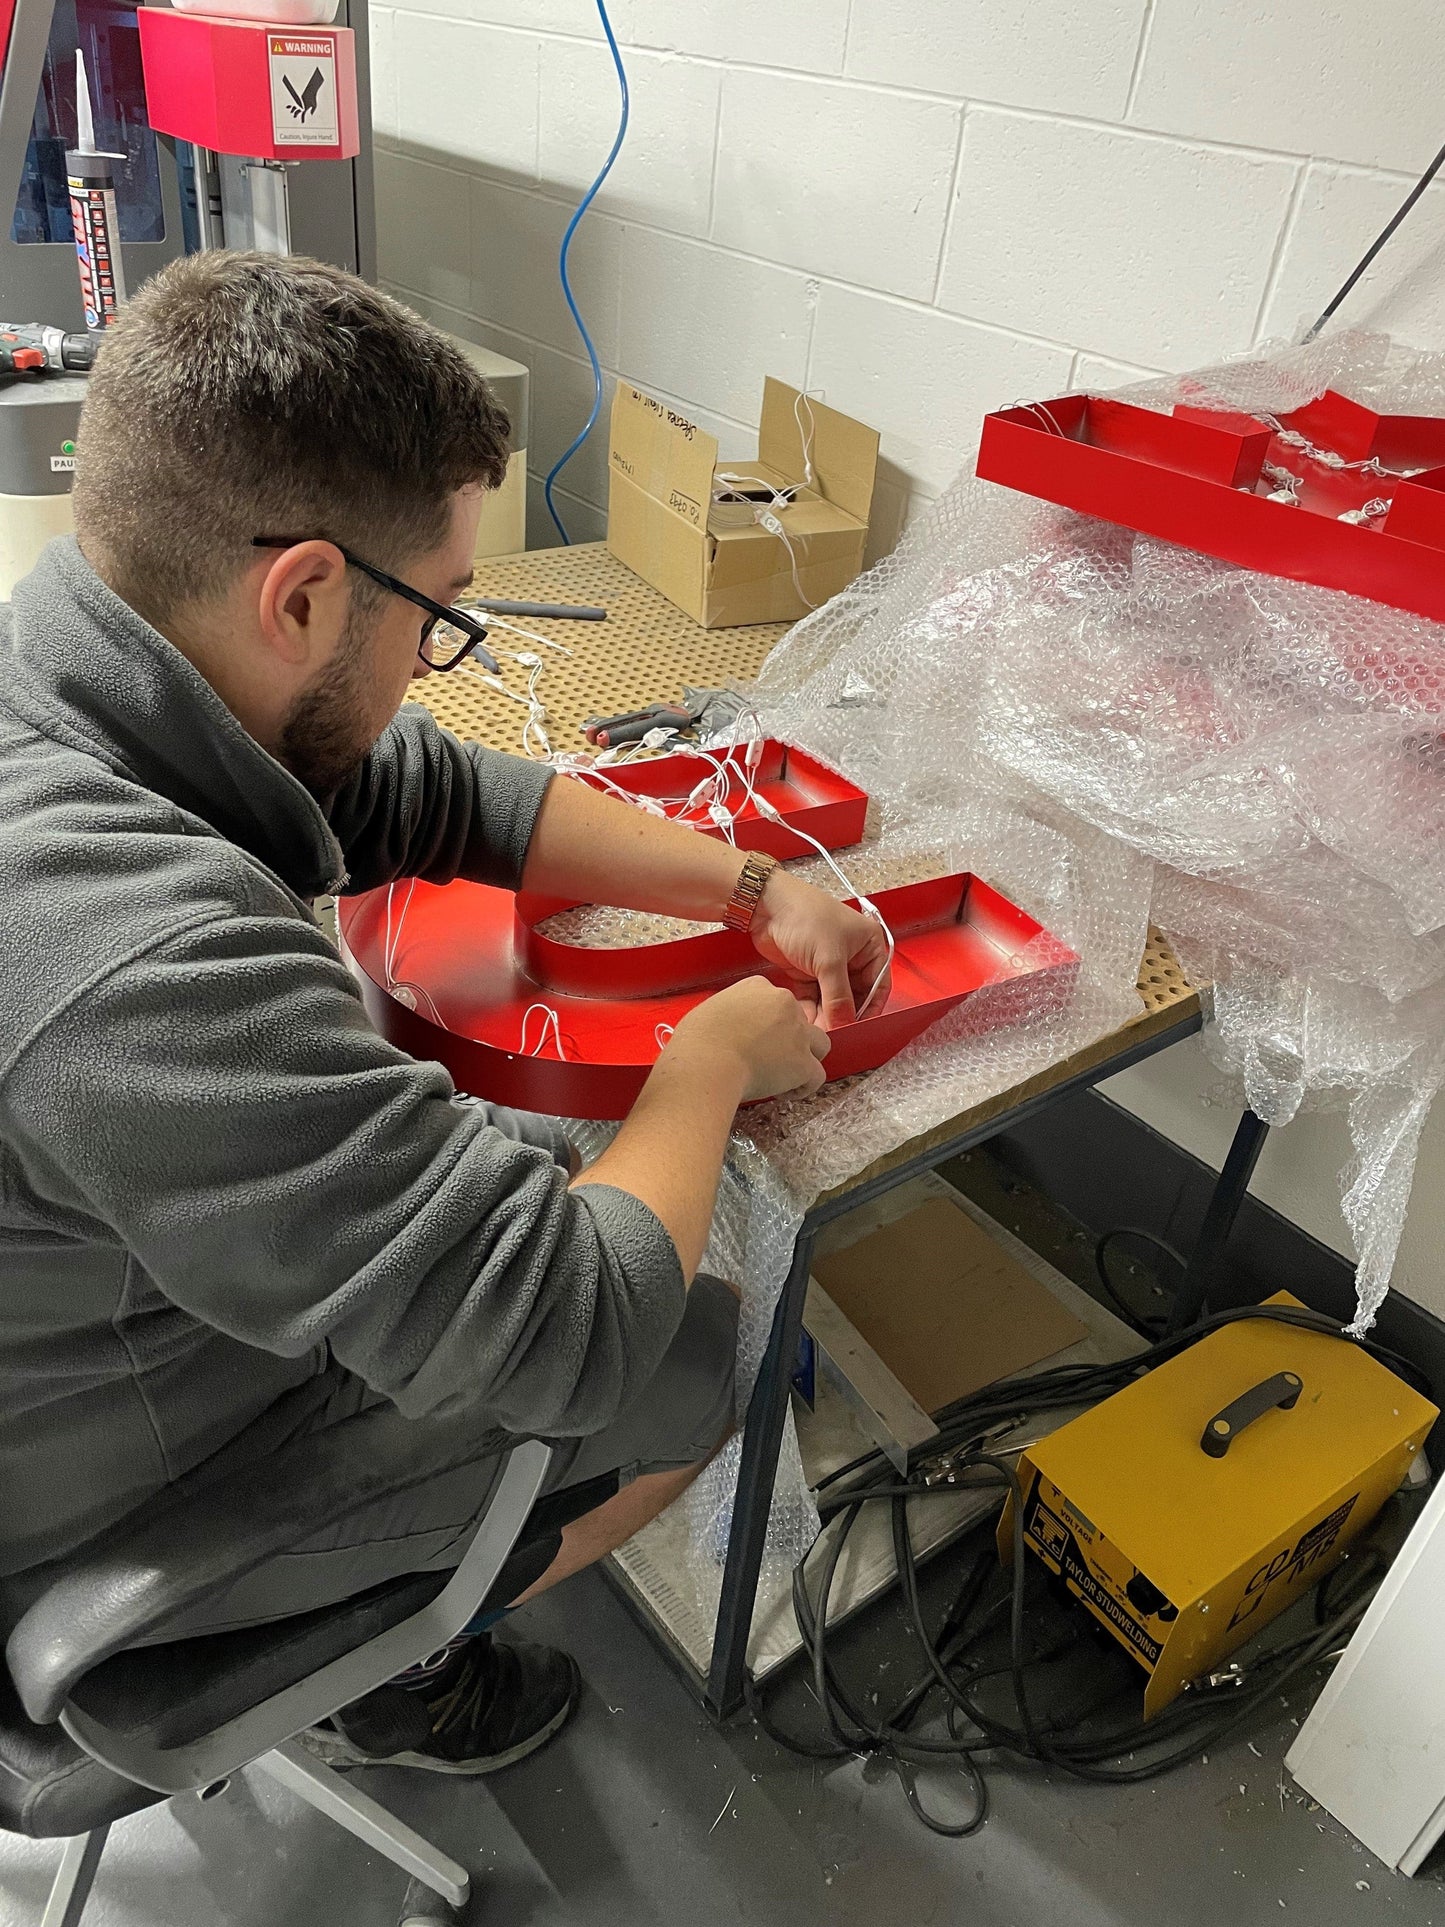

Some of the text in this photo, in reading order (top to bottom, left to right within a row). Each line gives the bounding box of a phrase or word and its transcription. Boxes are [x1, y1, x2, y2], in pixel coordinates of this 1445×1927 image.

[284, 42, 332, 54] WARNING
[1060, 1508, 1094, 1545] VOLTAGE
[1064, 1556, 1097, 1596] TAYLOR
[1095, 1590, 1157, 1659] STUDWELDING
